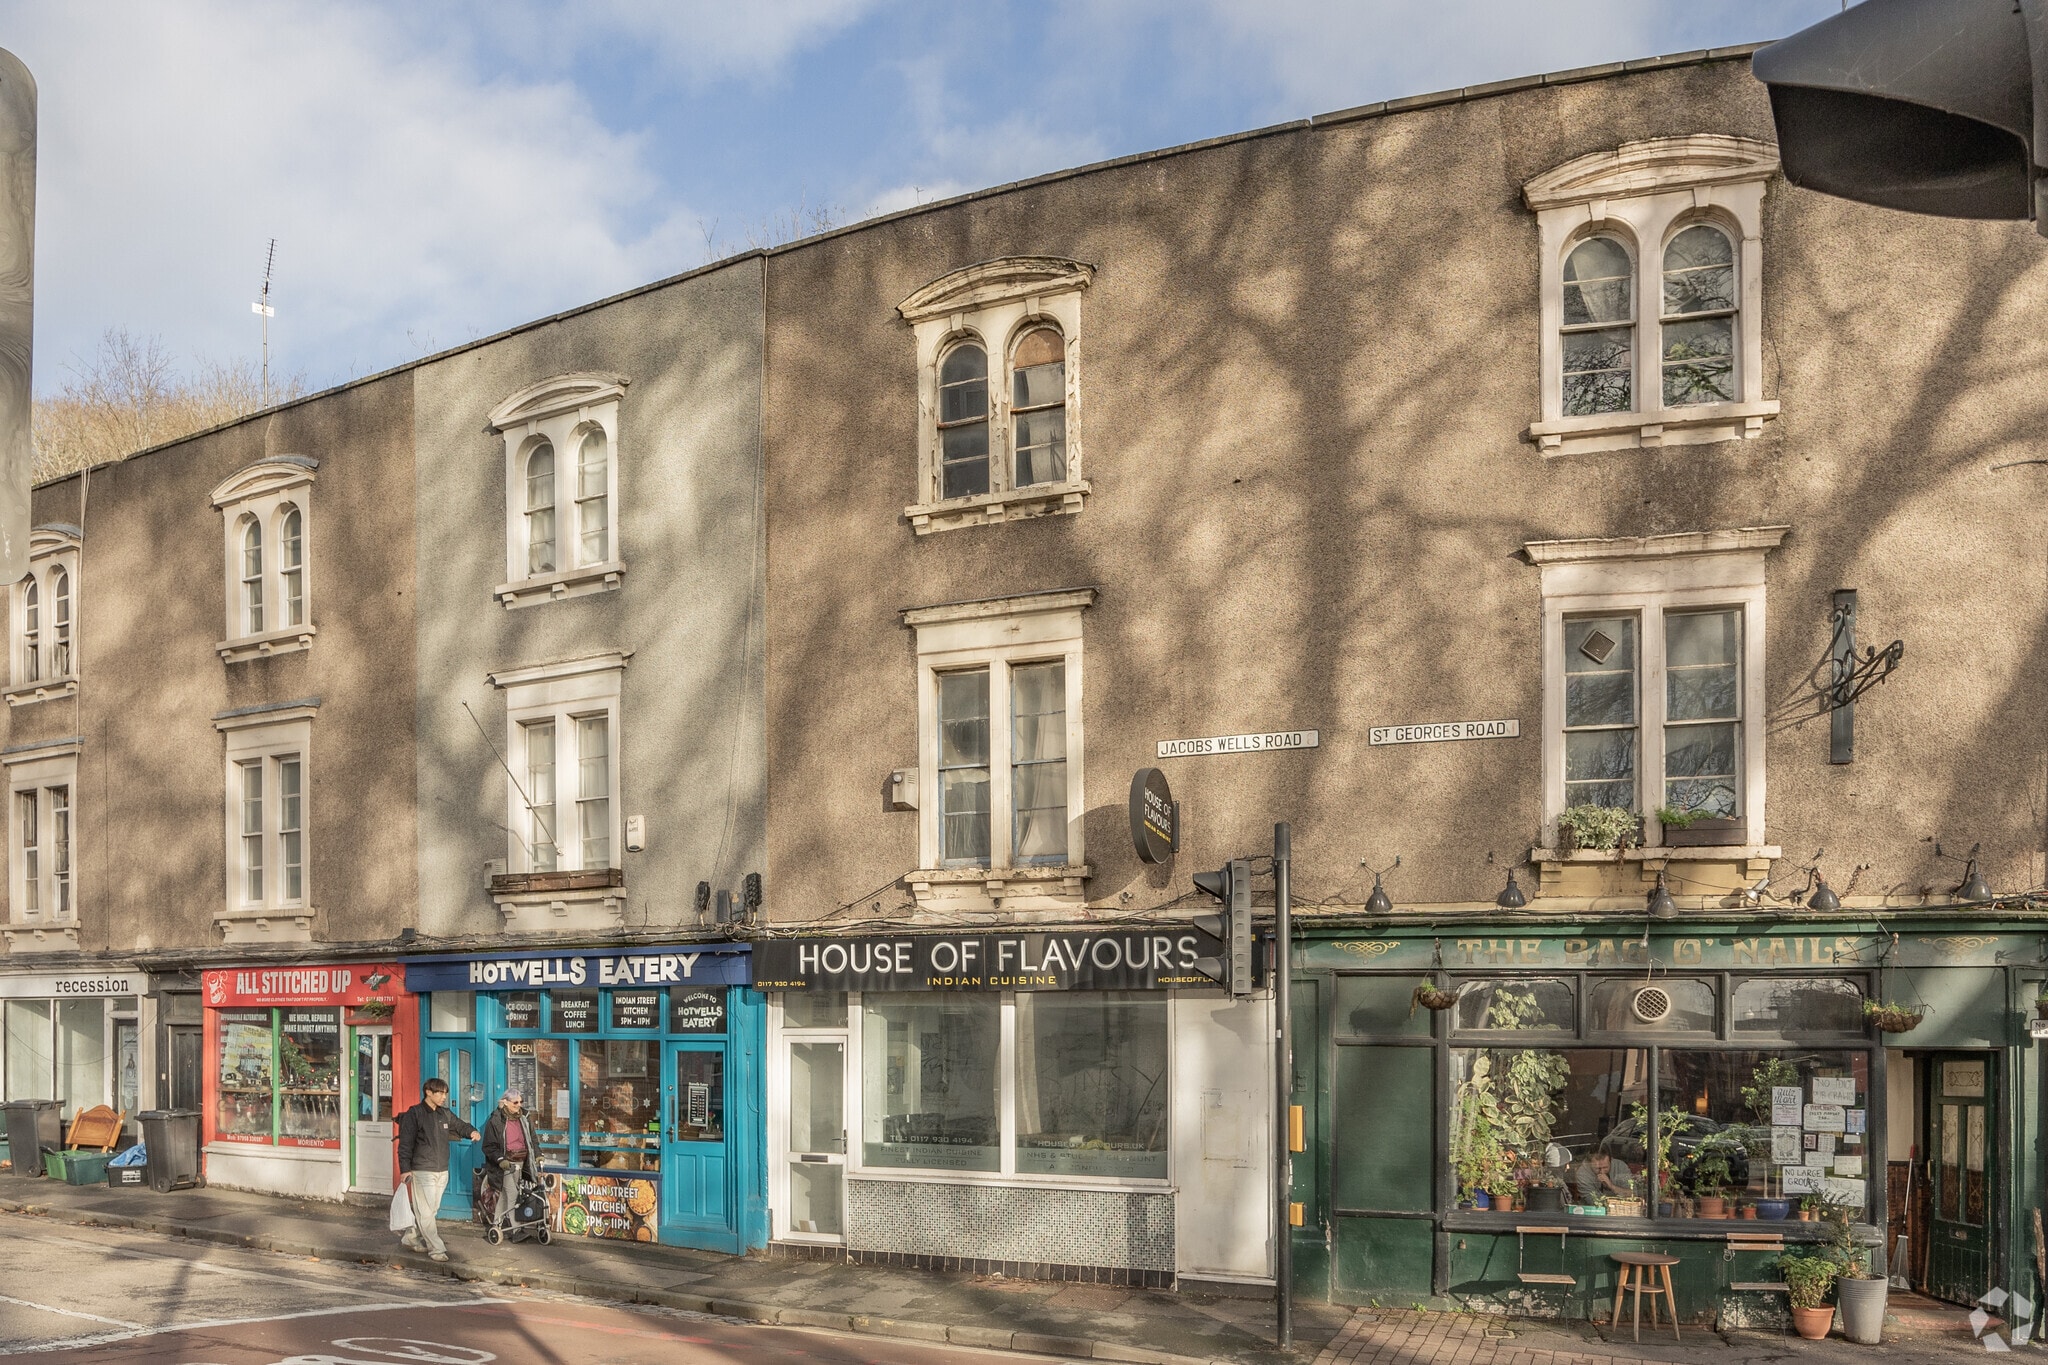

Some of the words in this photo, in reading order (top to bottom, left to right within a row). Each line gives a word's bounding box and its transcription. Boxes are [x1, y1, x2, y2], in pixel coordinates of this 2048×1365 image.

[1396, 725, 1461, 741] GEORGES
[1467, 722, 1506, 736] ROAD
[1161, 740, 1213, 755] JACOBS
[1218, 736, 1260, 750] WELLS
[1265, 733, 1302, 748] ROAD
[1144, 787, 1163, 811] HOUSE
[1163, 803, 1172, 818] OF
[1144, 803, 1171, 833] FLAVOURS
[800, 942, 914, 975] HOUSE
[930, 941, 980, 973] OF
[998, 935, 1198, 972] FLAVOURS
[1457, 938, 1543, 964] THE
[1564, 938, 1650, 964] BAG
[1732, 936, 1863, 964] NAILS
[469, 956, 587, 986] HOTWELLS
[599, 953, 701, 985] EATERY
[55, 976, 129, 993] recession
[236, 972, 259, 995] ALL
[262, 970, 329, 994] STITCHED
[332, 970, 351, 993] UP
[927, 977, 982, 986] INDIAN
[989, 975, 1056, 985] CUISINE
[615, 996, 636, 1005] INDIAN
[636, 996, 656, 1005] STREET
[683, 992, 709, 1004] WELCOME
[709, 994, 717, 1004] TO
[515, 1003, 532, 1011] COLD
[560, 1001, 590, 1009] BREAKFAST
[509, 1012, 528, 1021] DRINKS
[623, 1007, 649, 1015] KITCHEN
[678, 1006, 723, 1016] HOTWELLS
[565, 1021, 585, 1029] LUNCH
[637, 1017, 650, 1025] 11PM
[682, 1017, 718, 1028] EATERY
[297, 1024, 315, 1033] ALMOST
[315, 1024, 338, 1033] ANYTHING
[511, 1044, 533, 1053] OPEN
[380, 1073, 391, 1082] 30
[923, 1158, 967, 1167] LICENSED
[1784, 1168, 1795, 1176] NO
[1796, 1168, 1822, 1178] LARGE
[1787, 1178, 1819, 1188] GROUPS
[578, 1184, 608, 1196] INDIAN
[609, 1185, 639, 1199] STREET
[589, 1200, 627, 1213] KITCHEN
[586, 1215, 602, 1227] 5PM
[611, 1217, 630, 1230] 11PM
